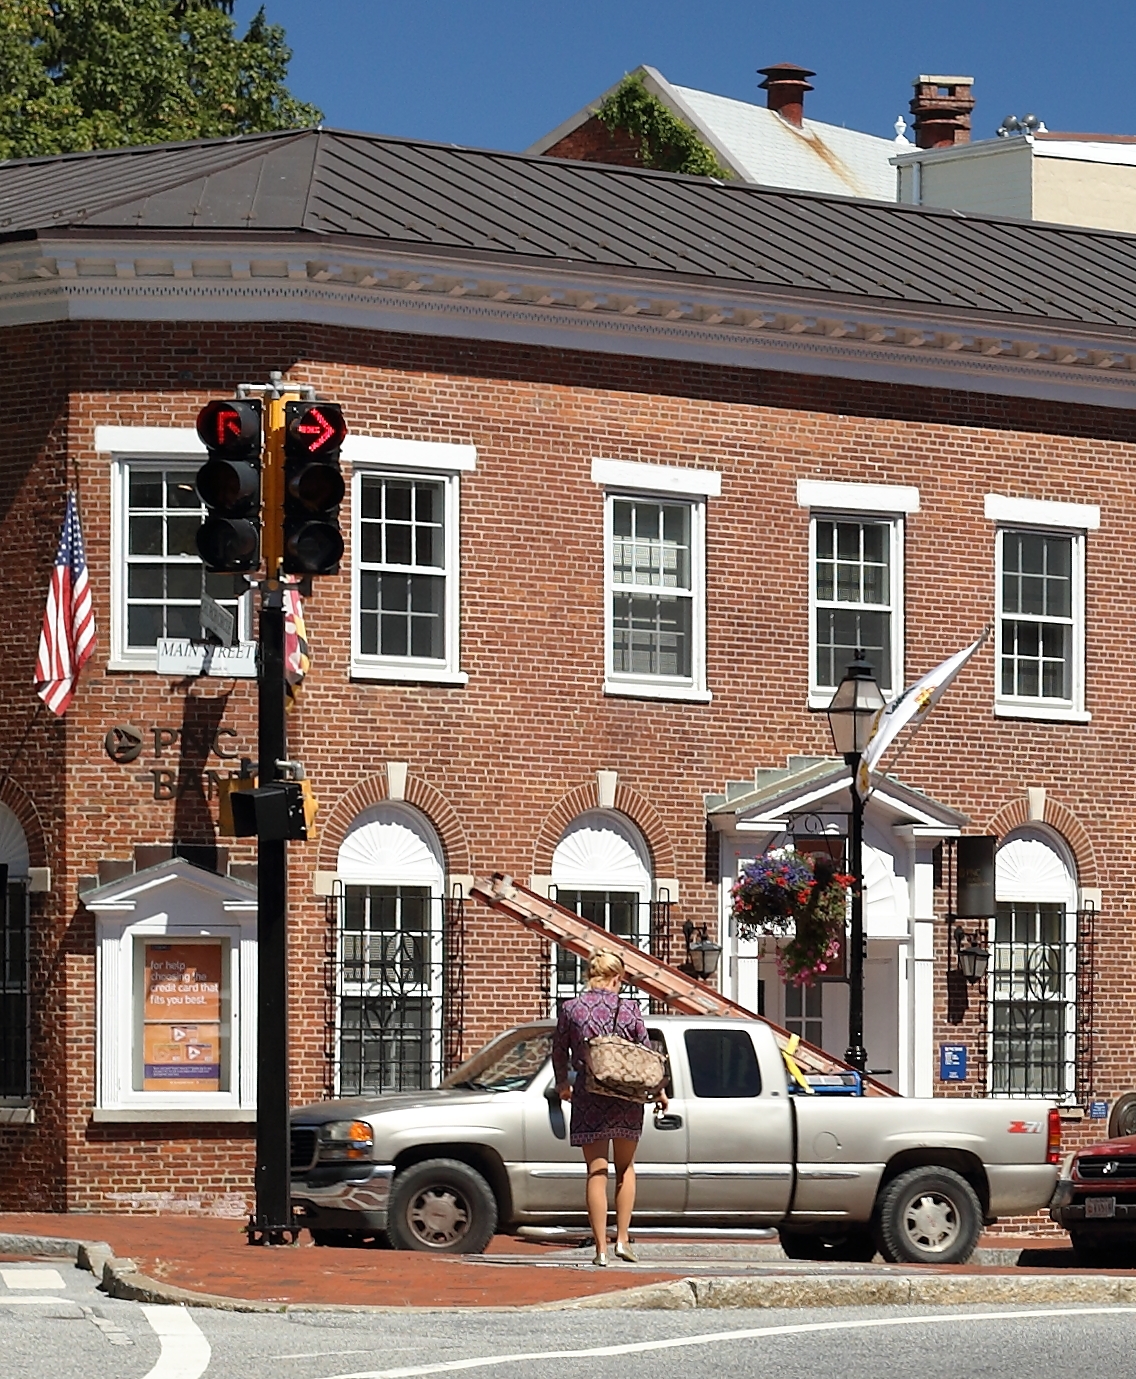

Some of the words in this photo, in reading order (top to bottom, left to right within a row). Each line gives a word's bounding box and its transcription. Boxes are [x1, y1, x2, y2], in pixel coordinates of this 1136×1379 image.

[161, 641, 199, 657] MAIN
[202, 643, 254, 659] STREET
[150, 727, 239, 759] PNC
[150, 961, 163, 969] for
[166, 961, 185, 971] help
[151, 972, 190, 982] choosing
[192, 971, 206, 980] the
[151, 983, 176, 992] credit
[178, 983, 198, 992] card
[201, 983, 218, 992] that
[150, 994, 165, 1004] fits
[167, 996, 183, 1006] you
[1007, 1121, 1044, 1134] Z71
